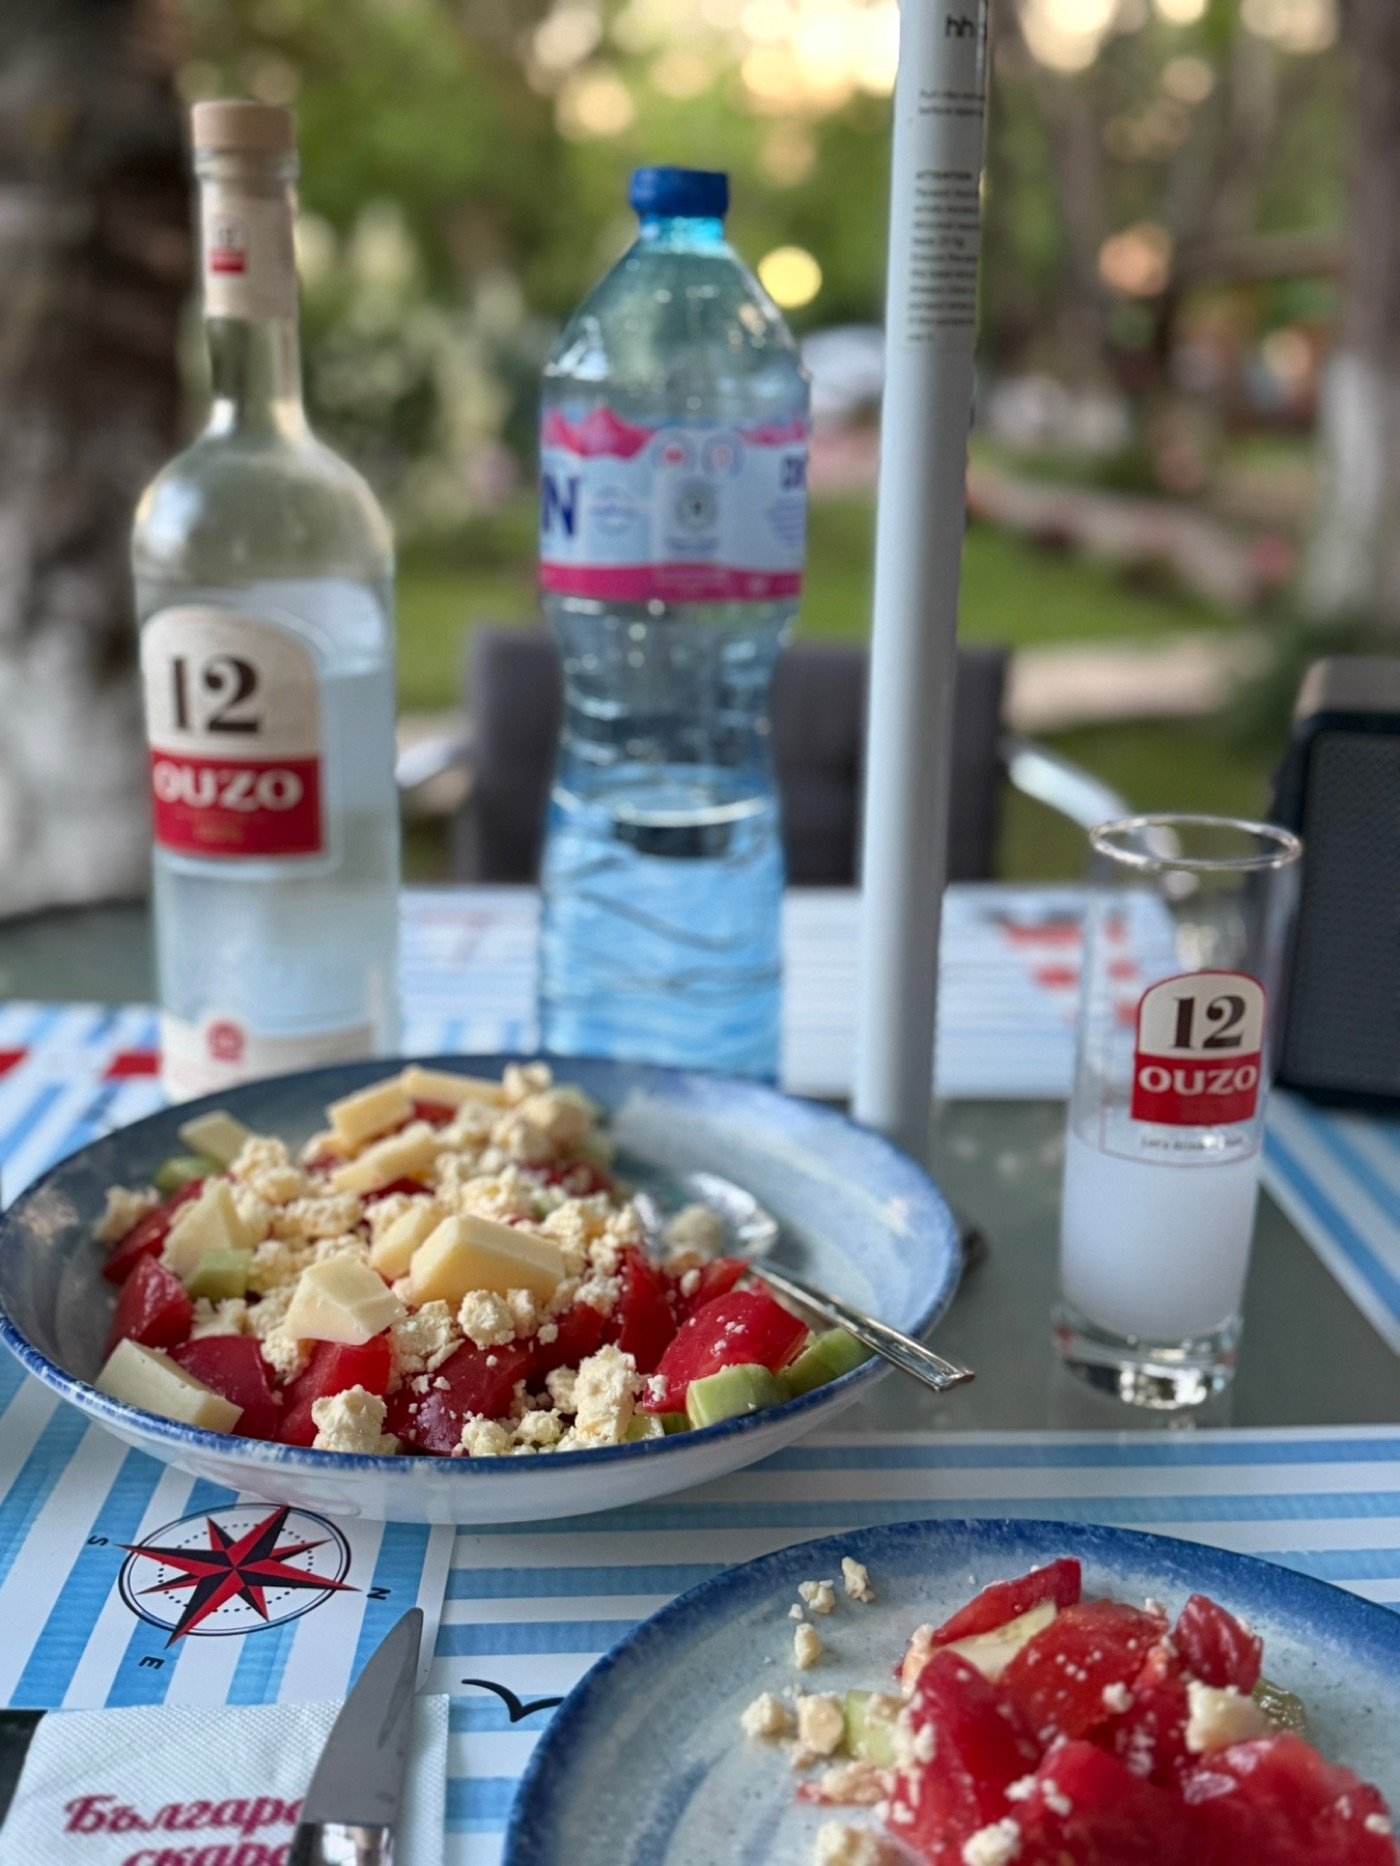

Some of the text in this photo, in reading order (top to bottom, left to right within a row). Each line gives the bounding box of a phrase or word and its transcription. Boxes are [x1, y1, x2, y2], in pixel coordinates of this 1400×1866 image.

[542, 473, 578, 538] N
[172, 654, 260, 734] 12
[152, 760, 304, 812] OUZO
[1172, 995, 1247, 1049] 12
[1137, 1064, 1258, 1096] OUZO
[86, 1534, 109, 1546] S
[366, 1586, 392, 1600] N
[138, 1655, 165, 1670] E
